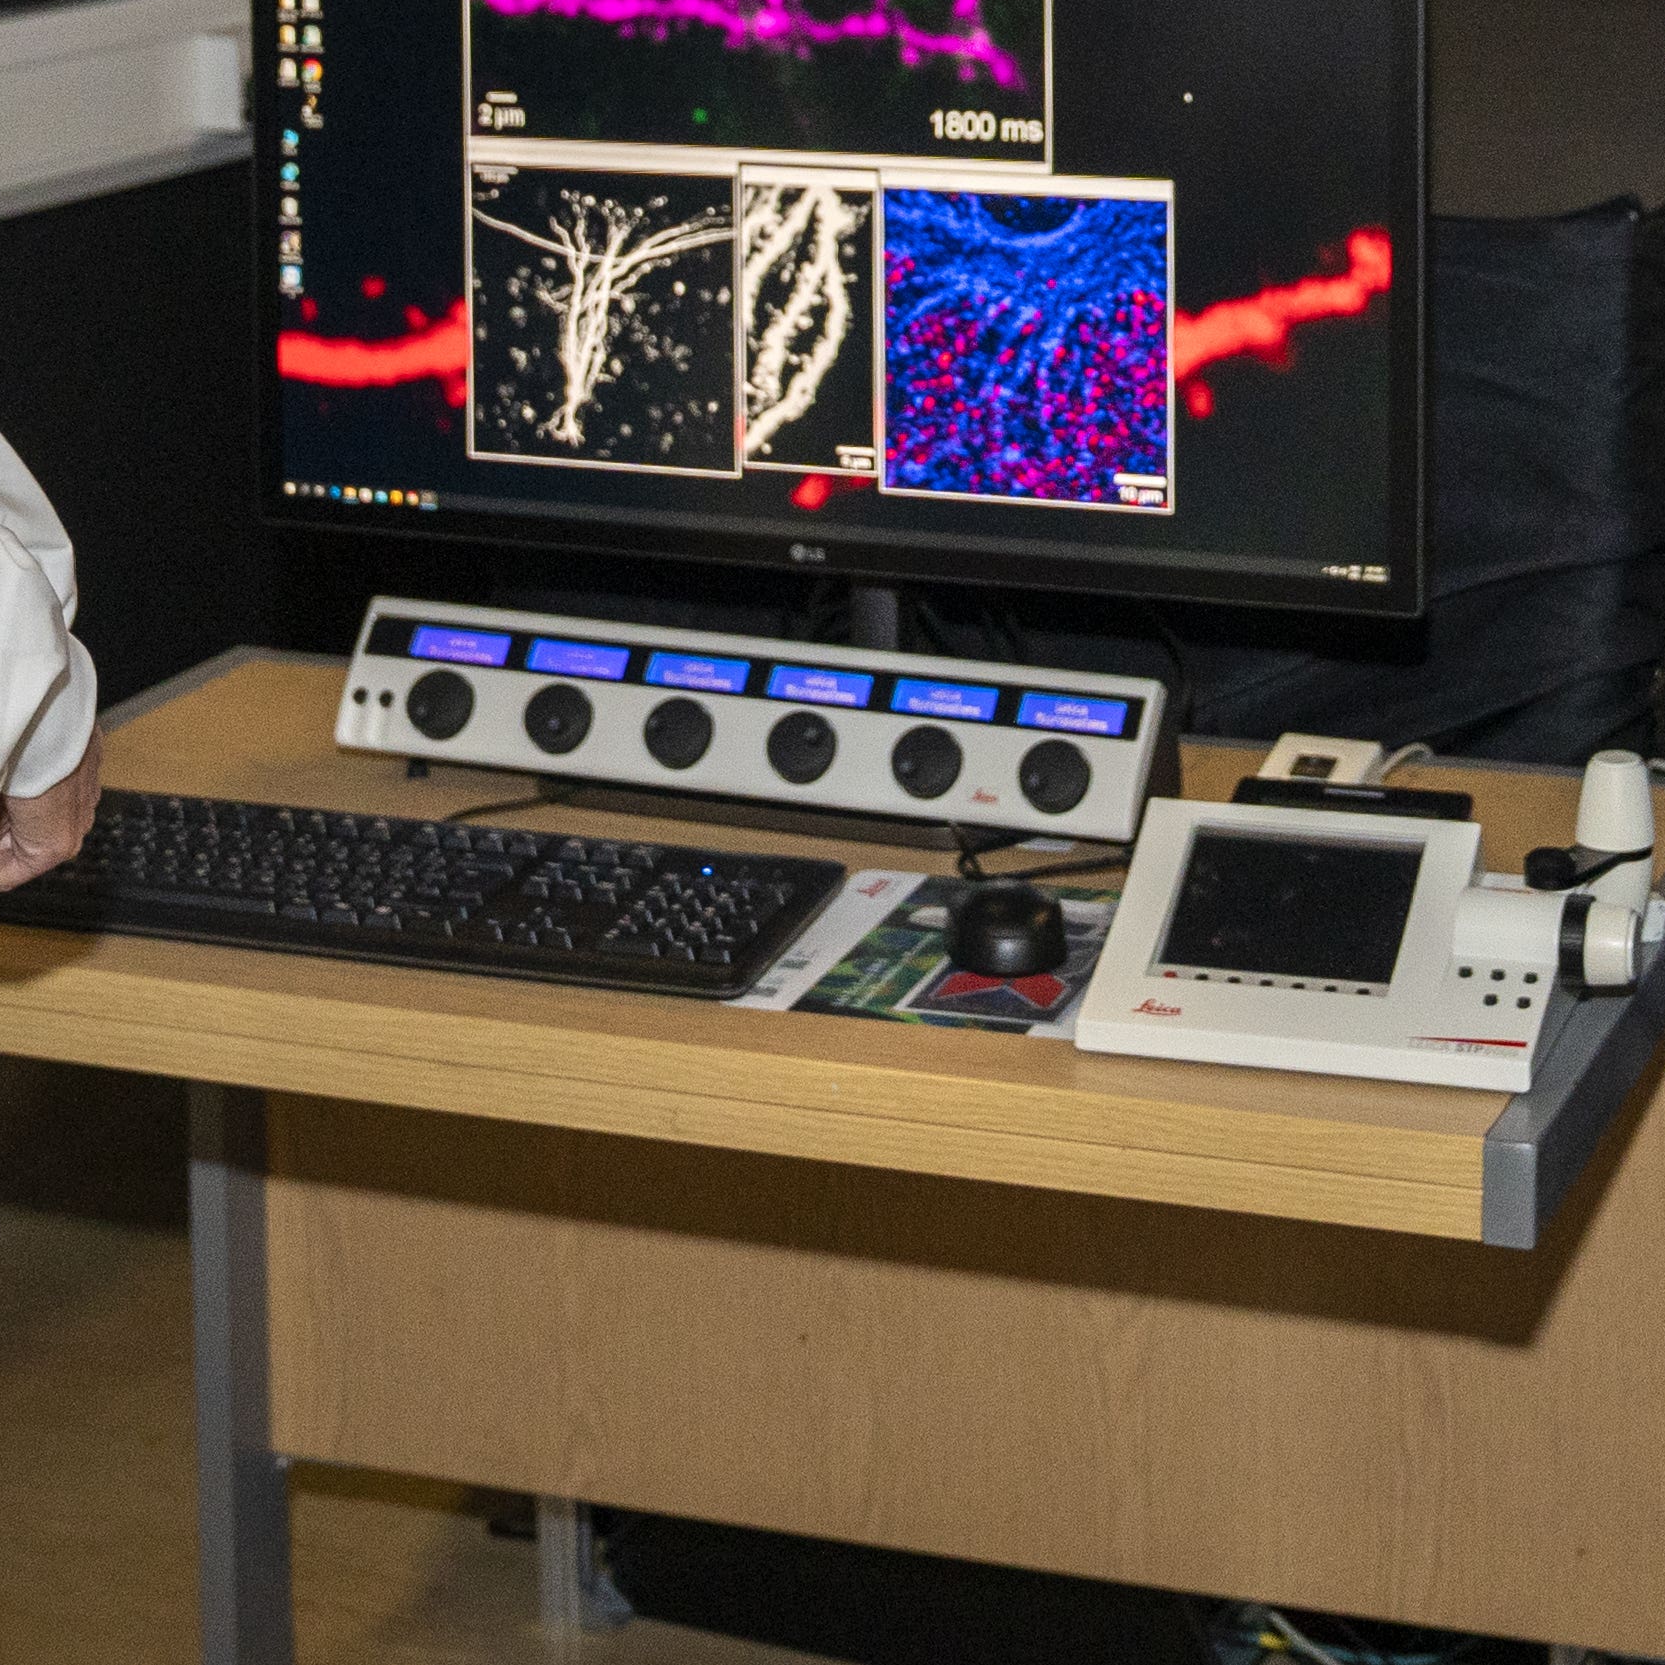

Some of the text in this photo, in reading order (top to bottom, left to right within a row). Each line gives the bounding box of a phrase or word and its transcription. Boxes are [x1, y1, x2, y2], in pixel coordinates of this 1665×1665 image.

[929, 108, 1044, 144] 1800 ms
[1132, 998, 1182, 1017] Leica
